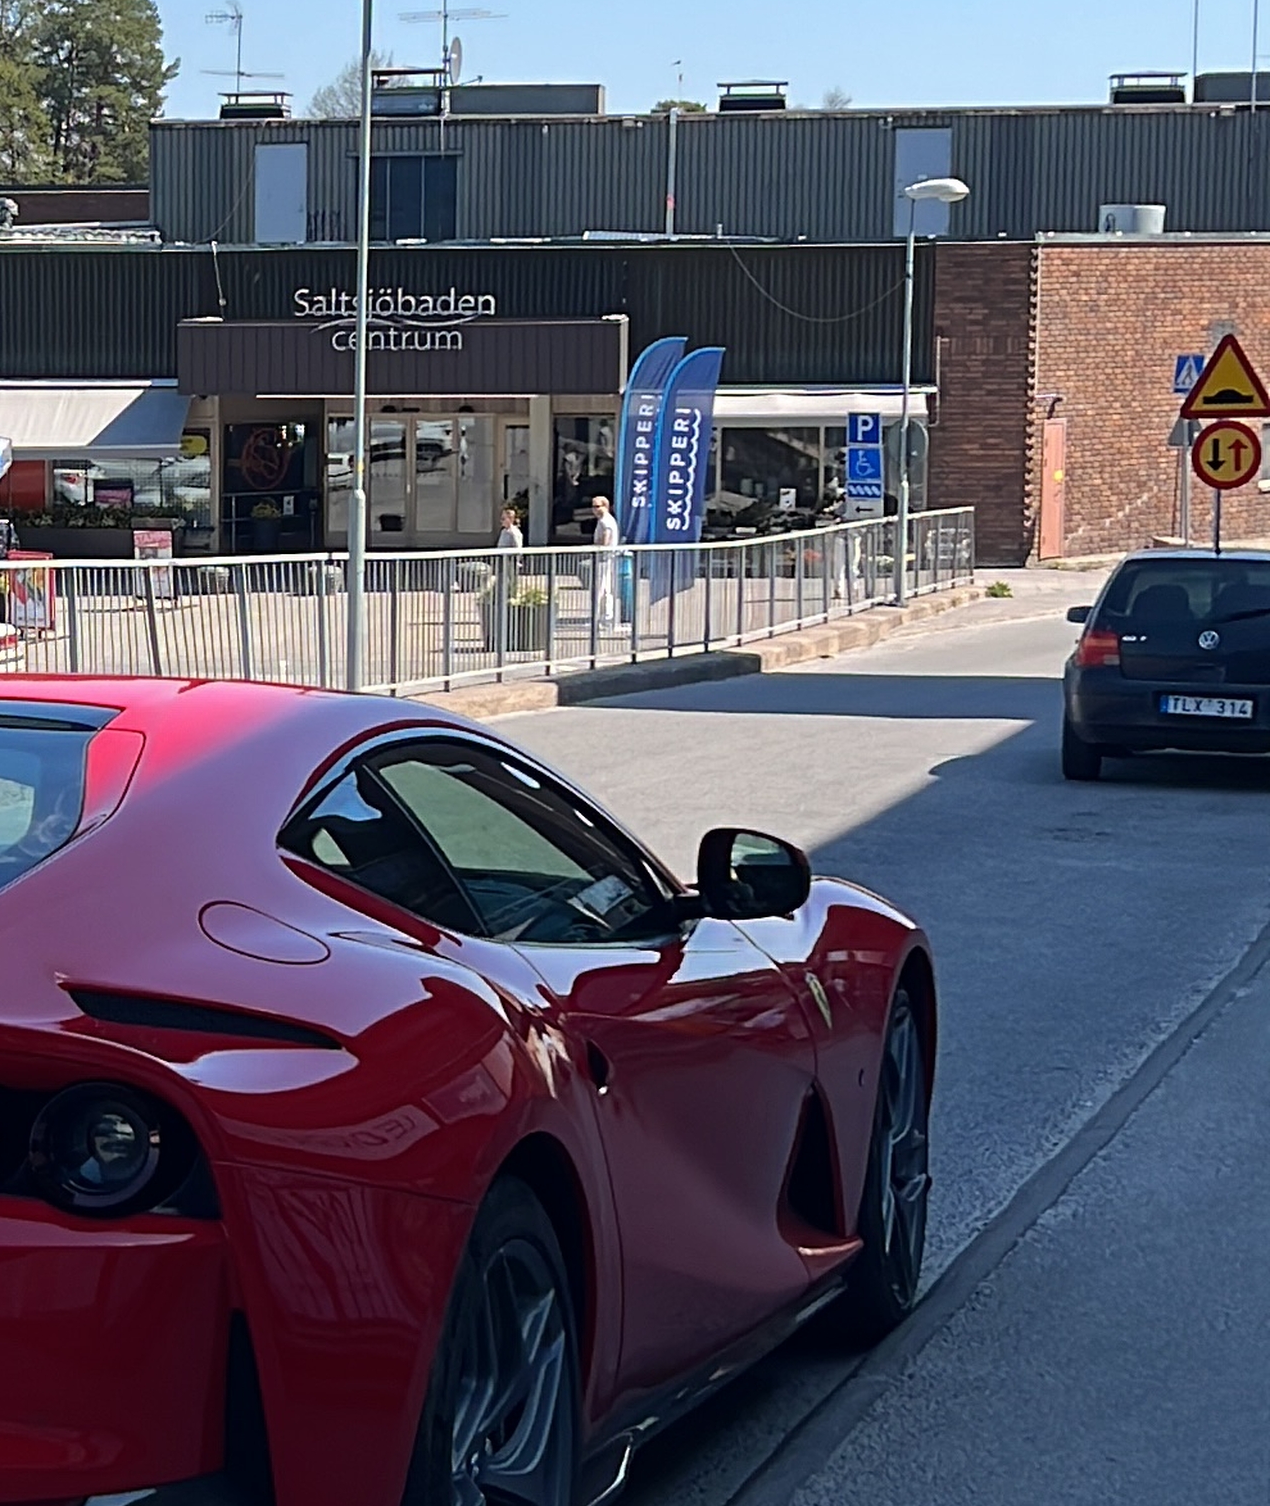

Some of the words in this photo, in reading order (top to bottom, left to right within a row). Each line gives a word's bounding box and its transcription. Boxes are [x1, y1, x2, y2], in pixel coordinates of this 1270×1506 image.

[294, 287, 496, 318] Saltsjöbaden
[332, 327, 463, 351] centrum
[857, 415, 874, 441] P
[632, 395, 655, 508] SKIPPERI
[666, 408, 692, 530] SKIPPERI
[1172, 697, 1204, 713] TLX
[1216, 700, 1248, 715] 314
